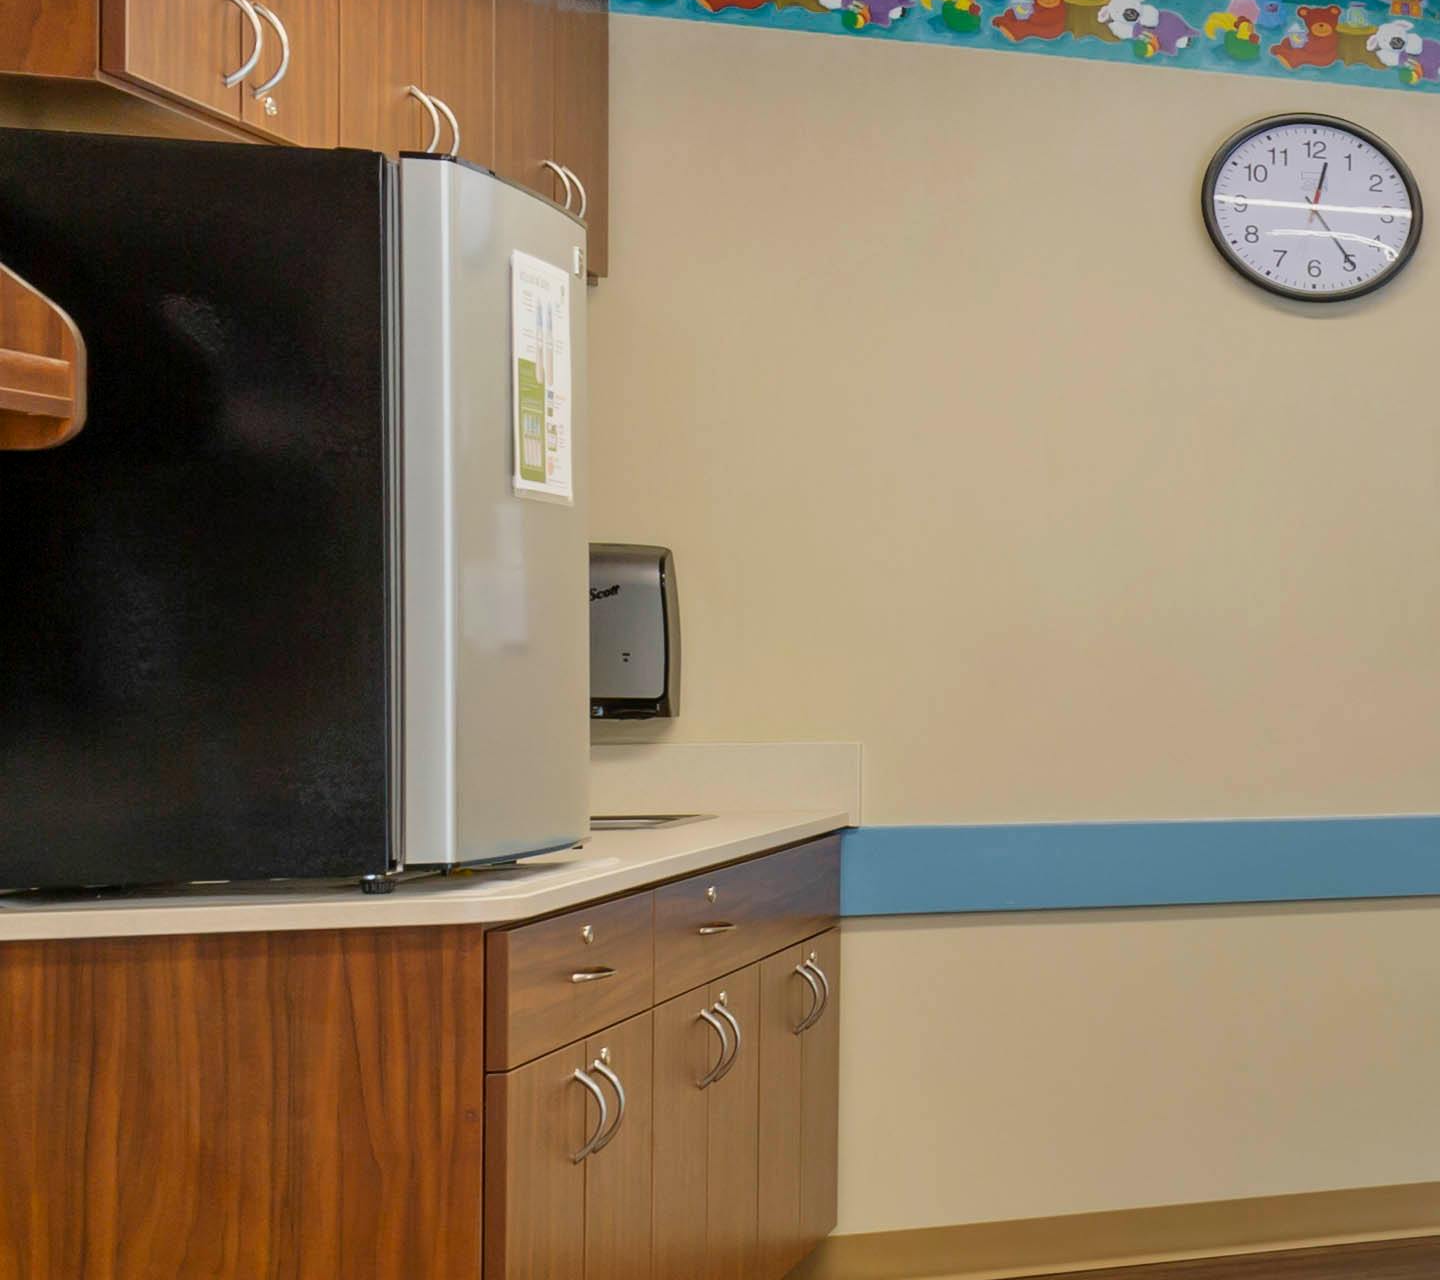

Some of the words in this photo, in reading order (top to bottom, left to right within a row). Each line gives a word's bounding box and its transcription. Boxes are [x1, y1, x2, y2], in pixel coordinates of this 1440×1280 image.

[1268, 147, 1288, 166] 11
[1303, 140, 1327, 159] 12
[1344, 153, 1352, 171] 1
[1244, 163, 1268, 183] 10
[1369, 174, 1384, 192] 2
[1233, 194, 1248, 213] 9
[1244, 225, 1260, 243] 8
[1273, 249, 1288, 267] 7
[1342, 254, 1357, 272] 5
[1307, 259, 1322, 278] 6
